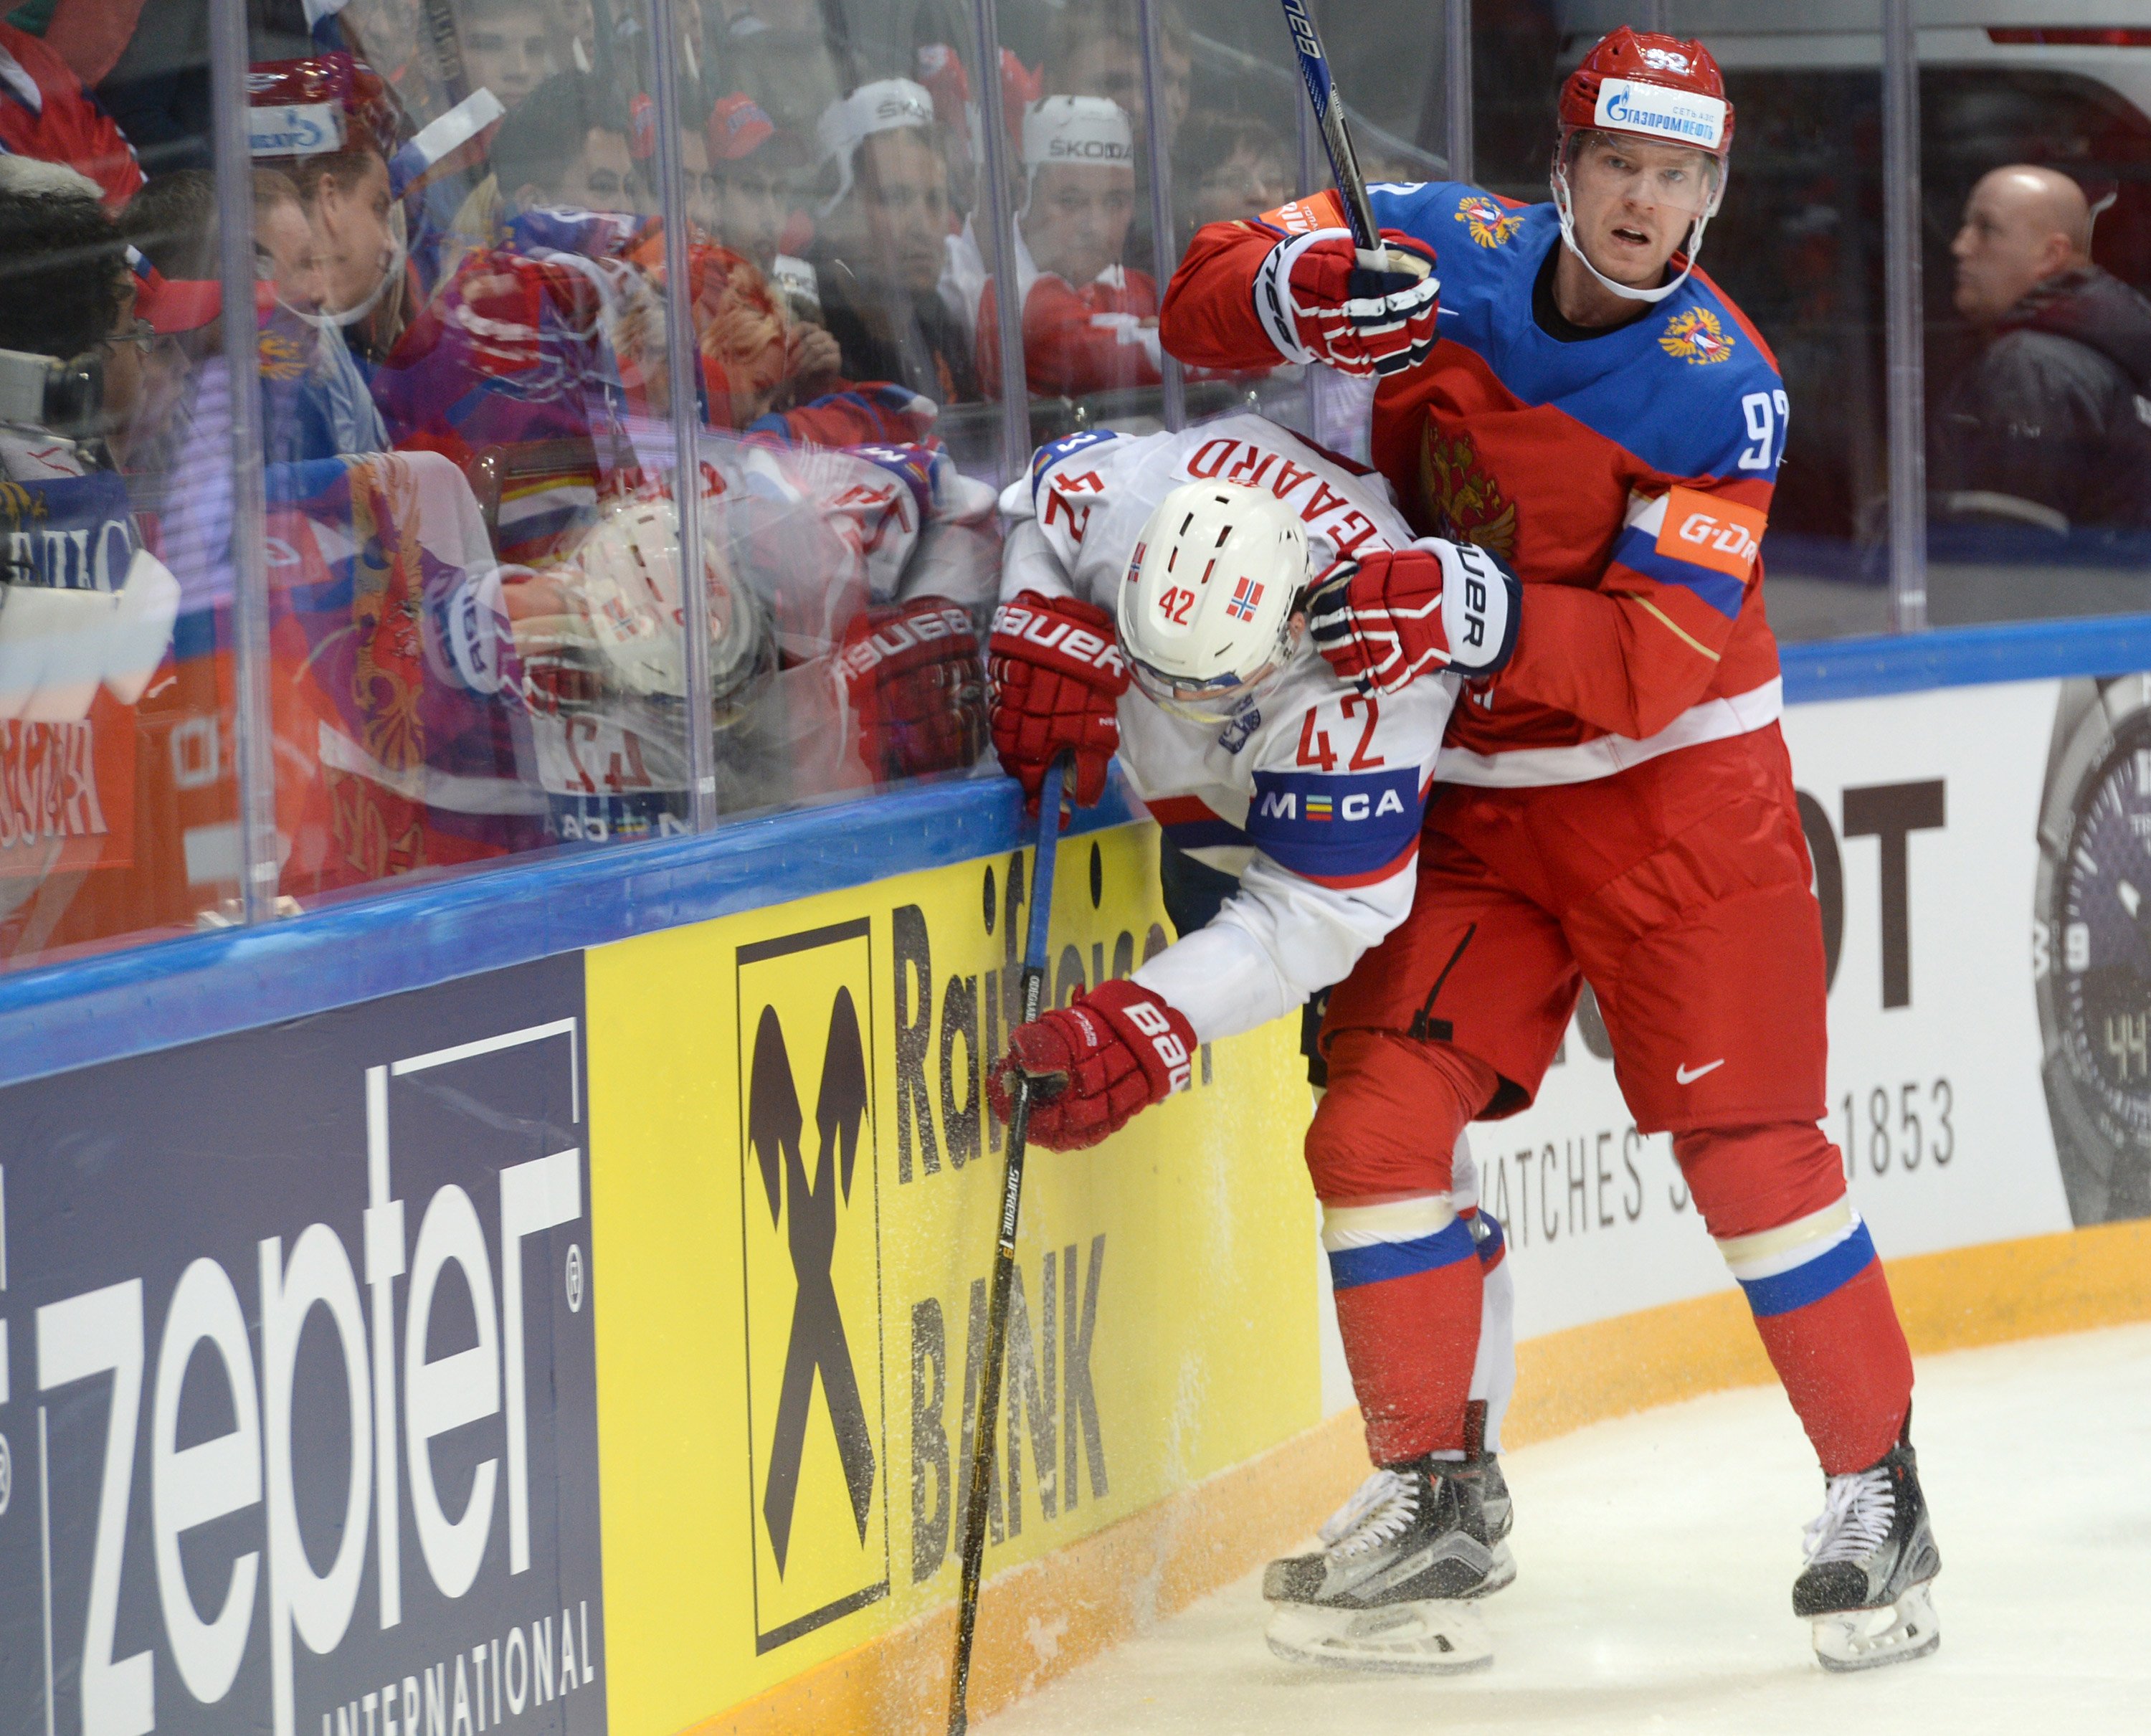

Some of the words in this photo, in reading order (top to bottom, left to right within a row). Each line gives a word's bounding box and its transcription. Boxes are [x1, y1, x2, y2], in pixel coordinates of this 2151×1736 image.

[1187, 439, 1393, 551] GAARD
[1158, 585, 1195, 626] 42
[1296, 693, 1385, 772] 42
[1841, 1076, 1956, 1180] 1853
[36, 1065, 581, 1736] zepter
[911, 1232, 1108, 1585] BANK
[323, 1600, 594, 1736] TERNATIONAL
